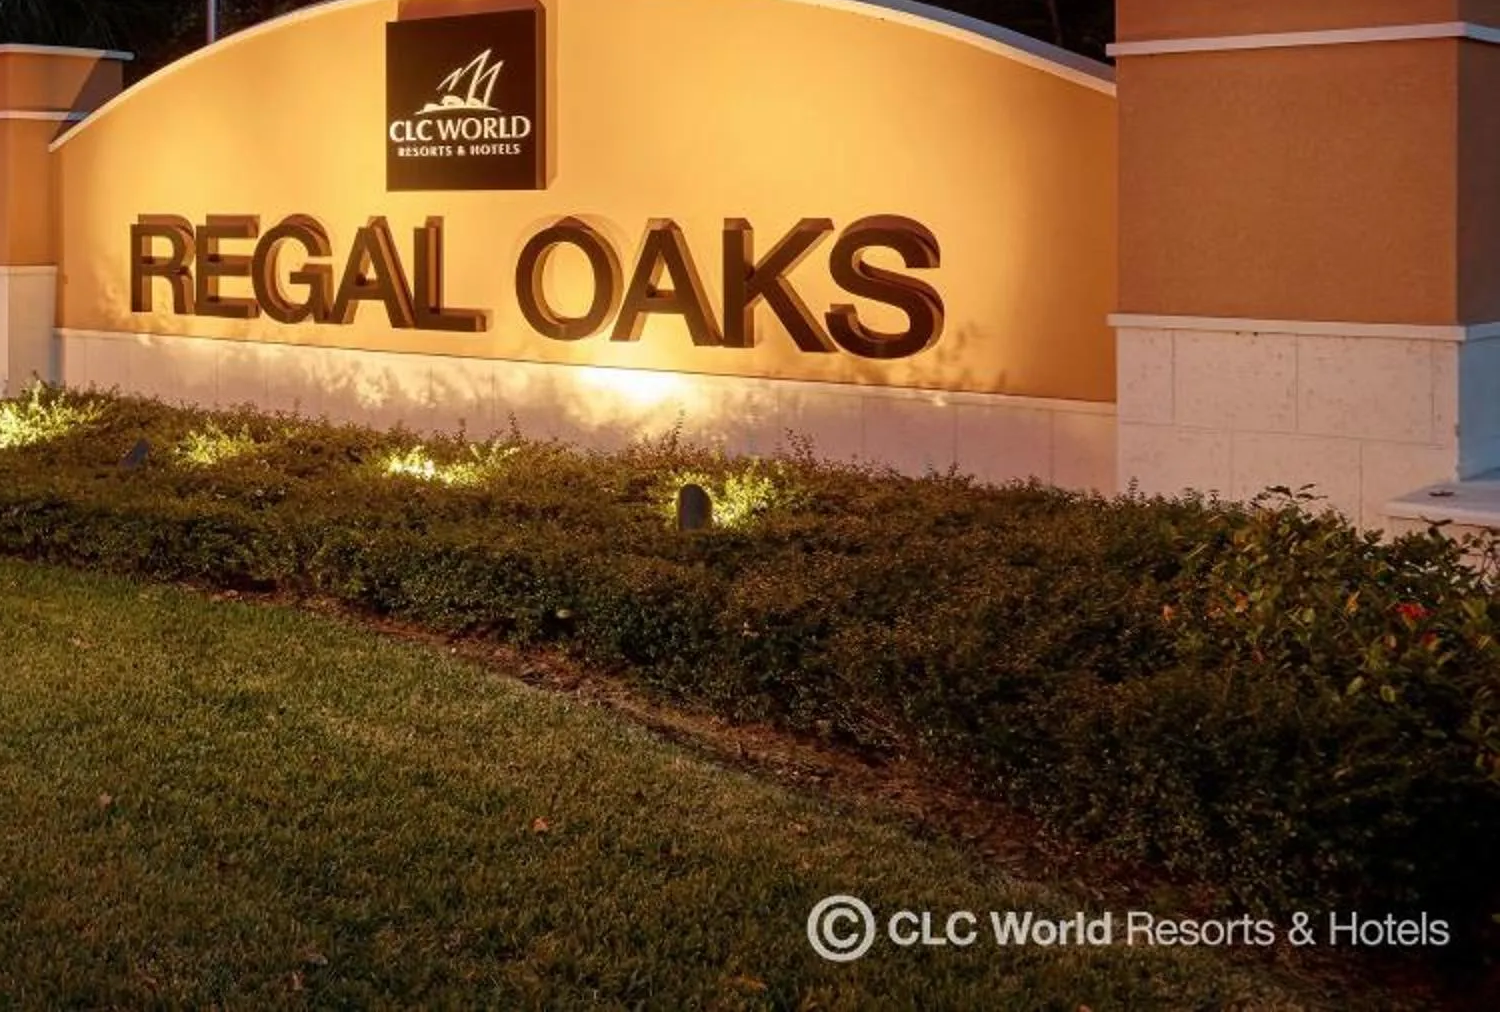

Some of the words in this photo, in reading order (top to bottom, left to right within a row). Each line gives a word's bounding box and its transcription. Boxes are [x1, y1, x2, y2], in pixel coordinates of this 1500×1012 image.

[389, 119, 433, 143] CLC
[436, 115, 532, 141] WORLD
[397, 144, 453, 157] RESORTS
[456, 145, 466, 157] &
[469, 143, 522, 156] HOTELS
[129, 212, 494, 334] REGAL
[513, 213, 946, 360] OAKS
